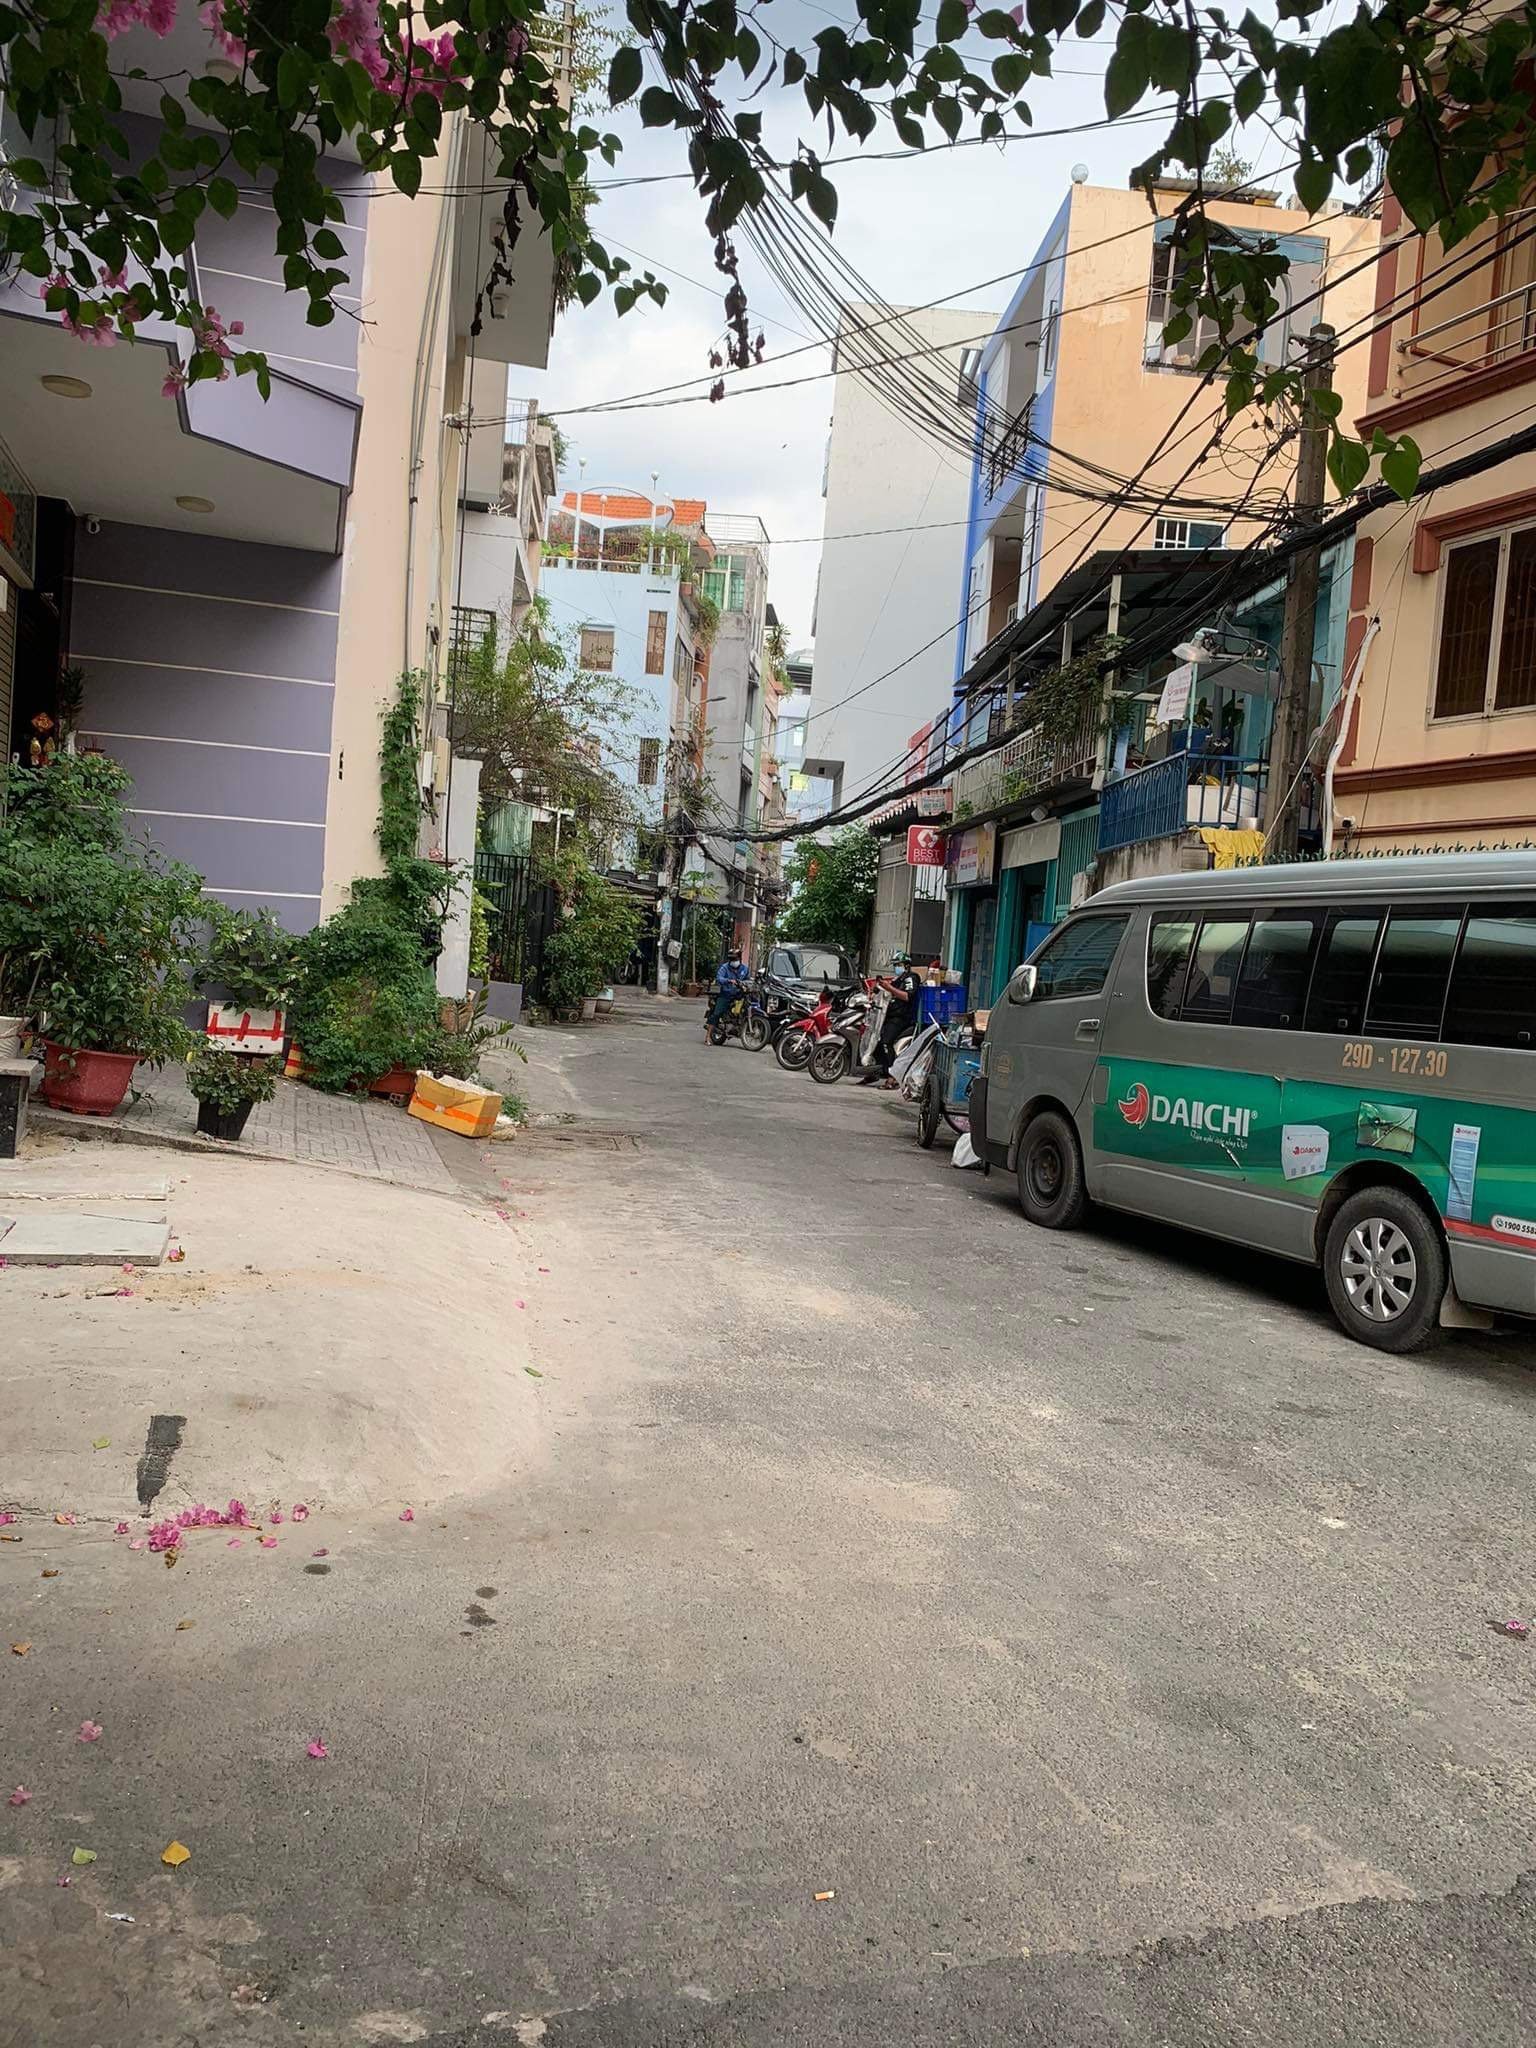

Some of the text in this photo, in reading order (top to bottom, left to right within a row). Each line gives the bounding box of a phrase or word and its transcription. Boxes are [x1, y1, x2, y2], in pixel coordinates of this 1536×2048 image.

[913, 848, 940, 858] BEST
[1342, 1043, 1373, 1069] 29D
[1391, 1048, 1448, 1077] 127.30
[1504, 1221, 1520, 1231] 1900
